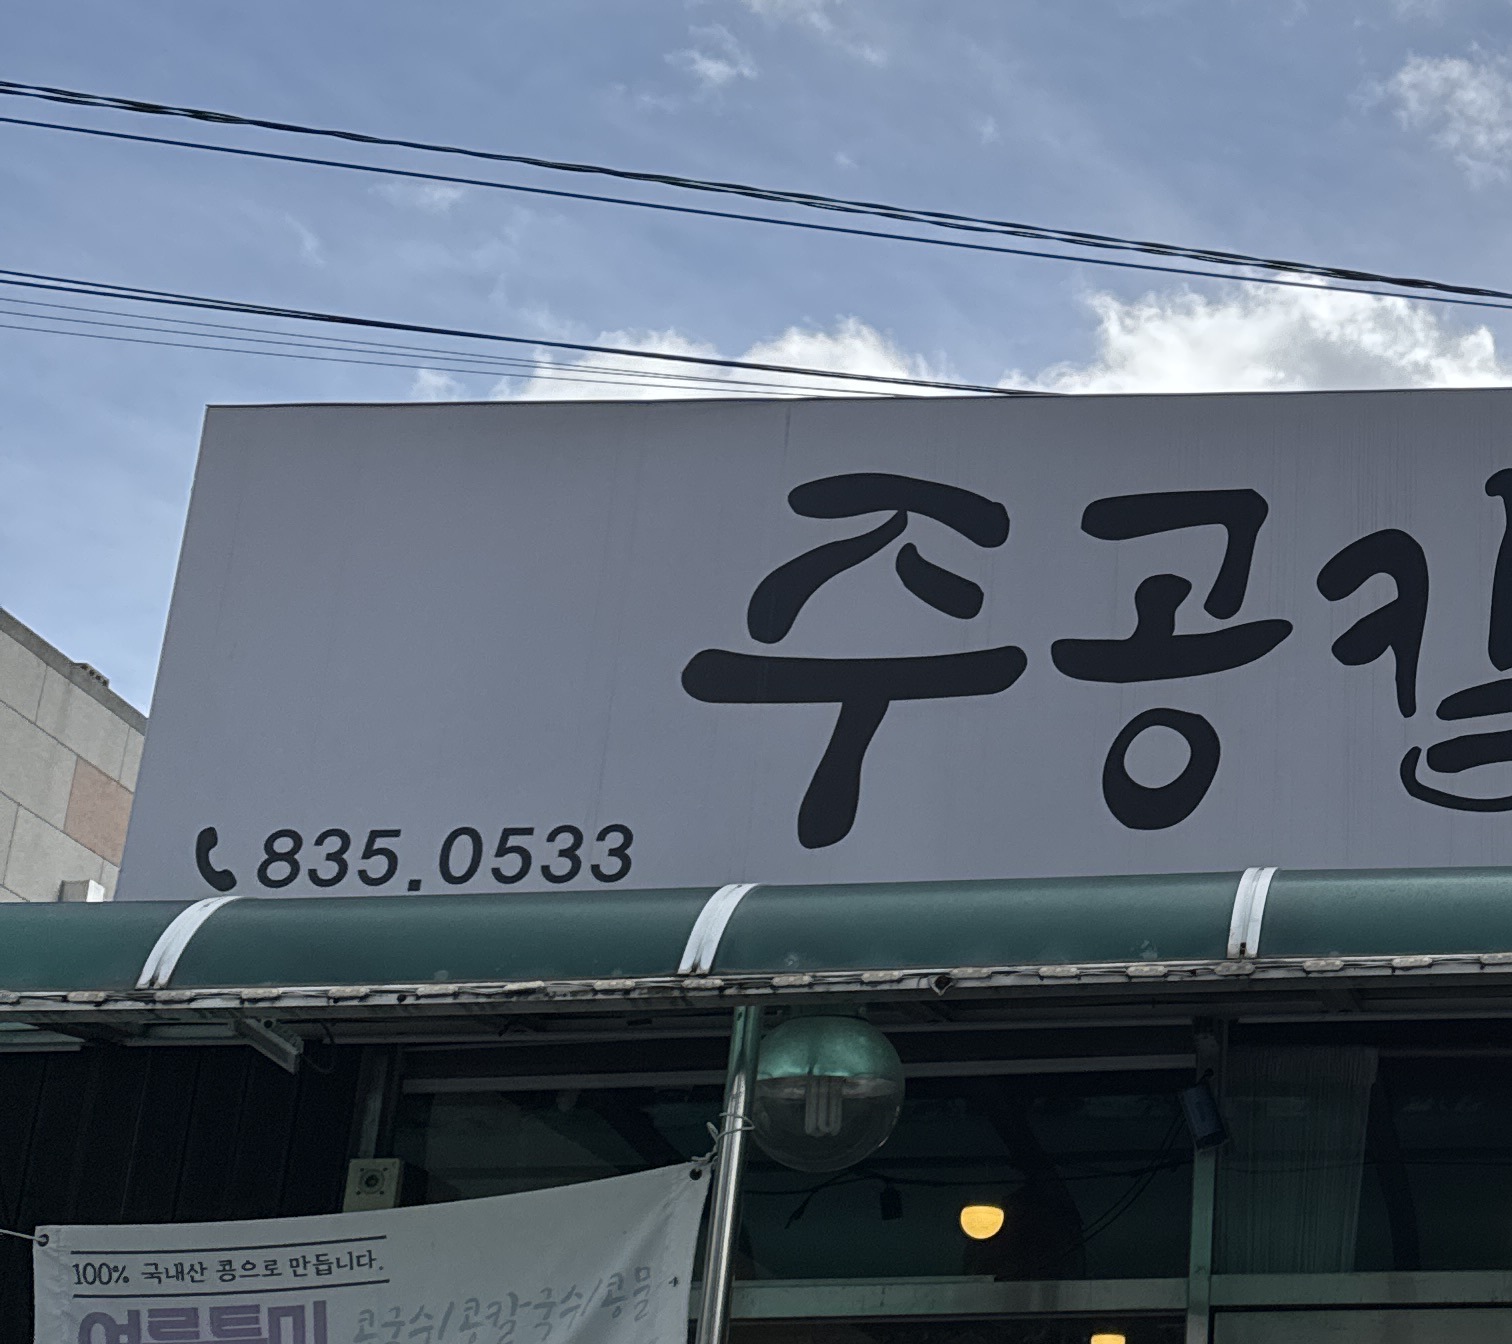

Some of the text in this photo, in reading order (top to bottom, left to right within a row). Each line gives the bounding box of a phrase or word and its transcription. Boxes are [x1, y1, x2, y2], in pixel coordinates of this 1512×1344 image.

[256, 823, 634, 893] 835.0533
[72, 1249, 385, 1286] 100% 국내산 콩으로 만듭니다.
